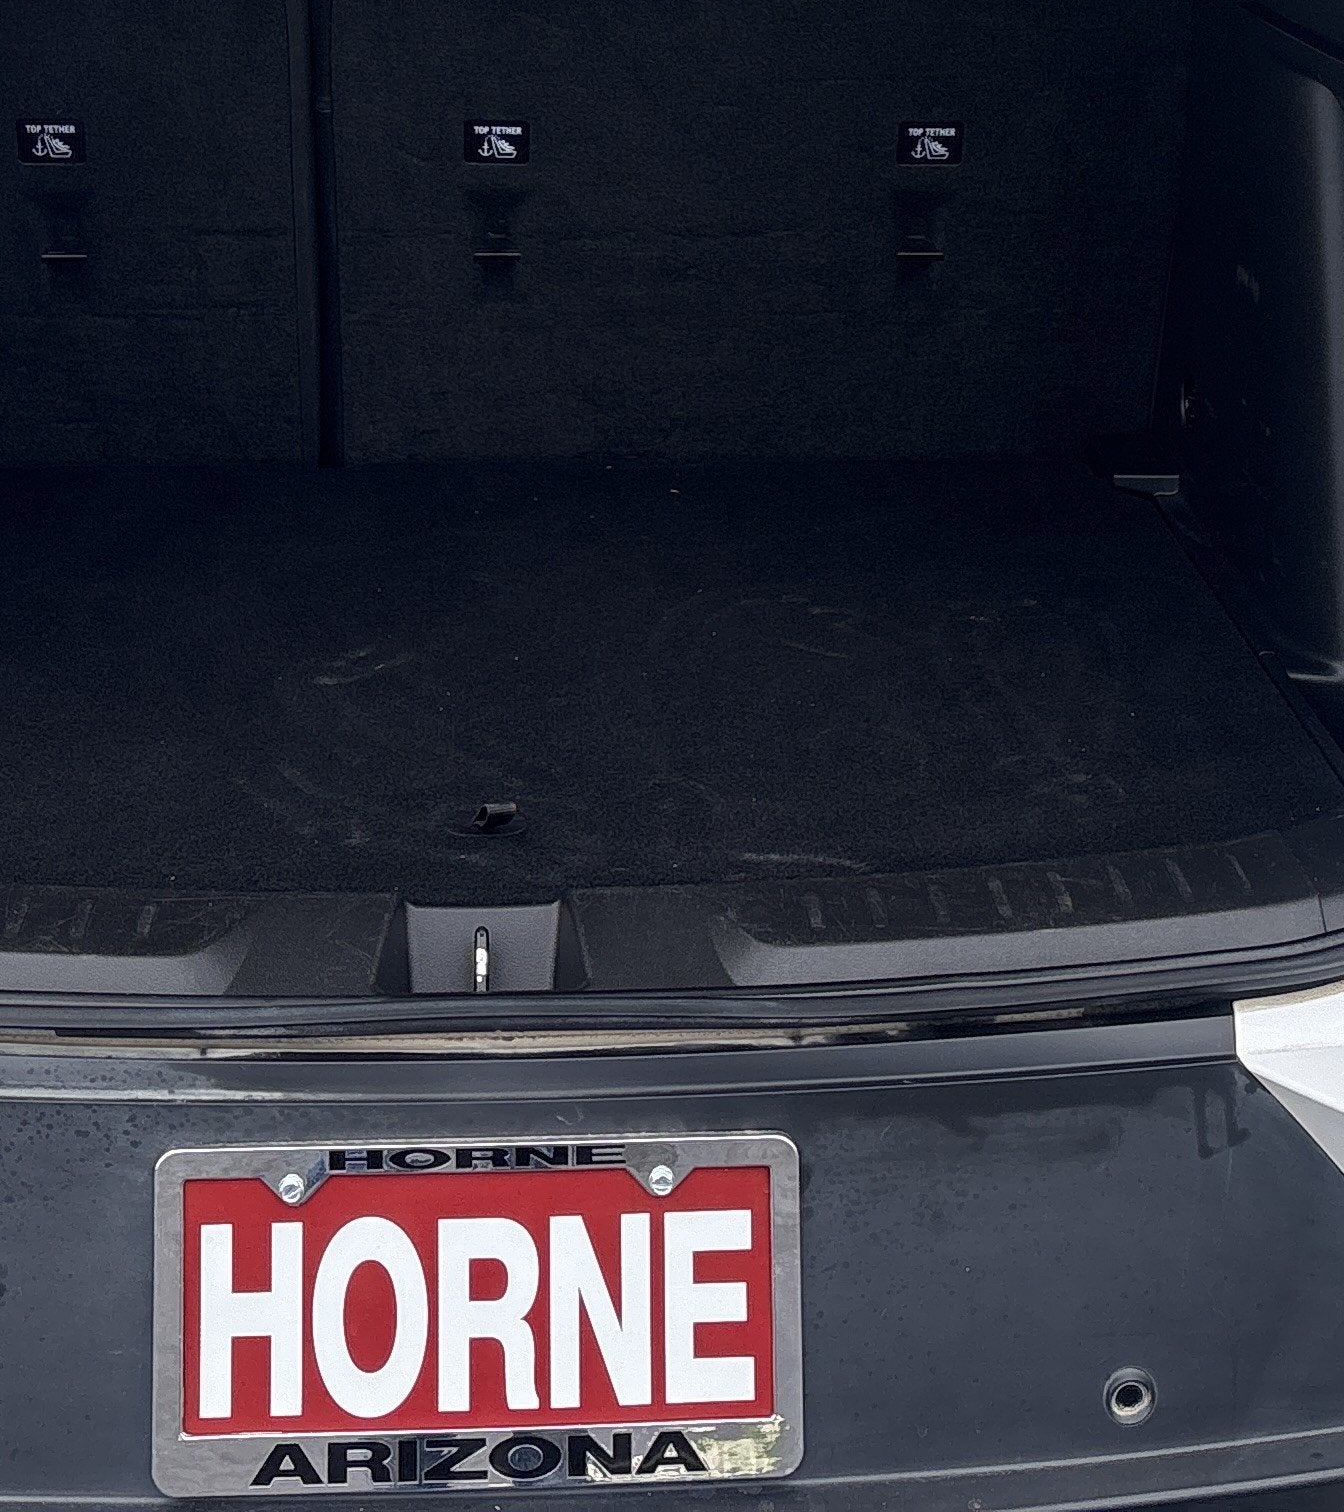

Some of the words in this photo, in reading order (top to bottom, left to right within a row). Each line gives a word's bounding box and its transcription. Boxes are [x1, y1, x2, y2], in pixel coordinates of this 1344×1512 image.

[25, 124, 41, 134] TOP
[43, 124, 76, 134] TETHER
[473, 125, 490, 135] TOP
[490, 126, 523, 136] TETHER
[908, 127, 924, 137] TOP
[925, 127, 956, 137] TETHER
[328, 1144, 627, 1171] HORNE
[198, 1208, 756, 1420] HORNE
[249, 1430, 708, 1487] ARIZONA
